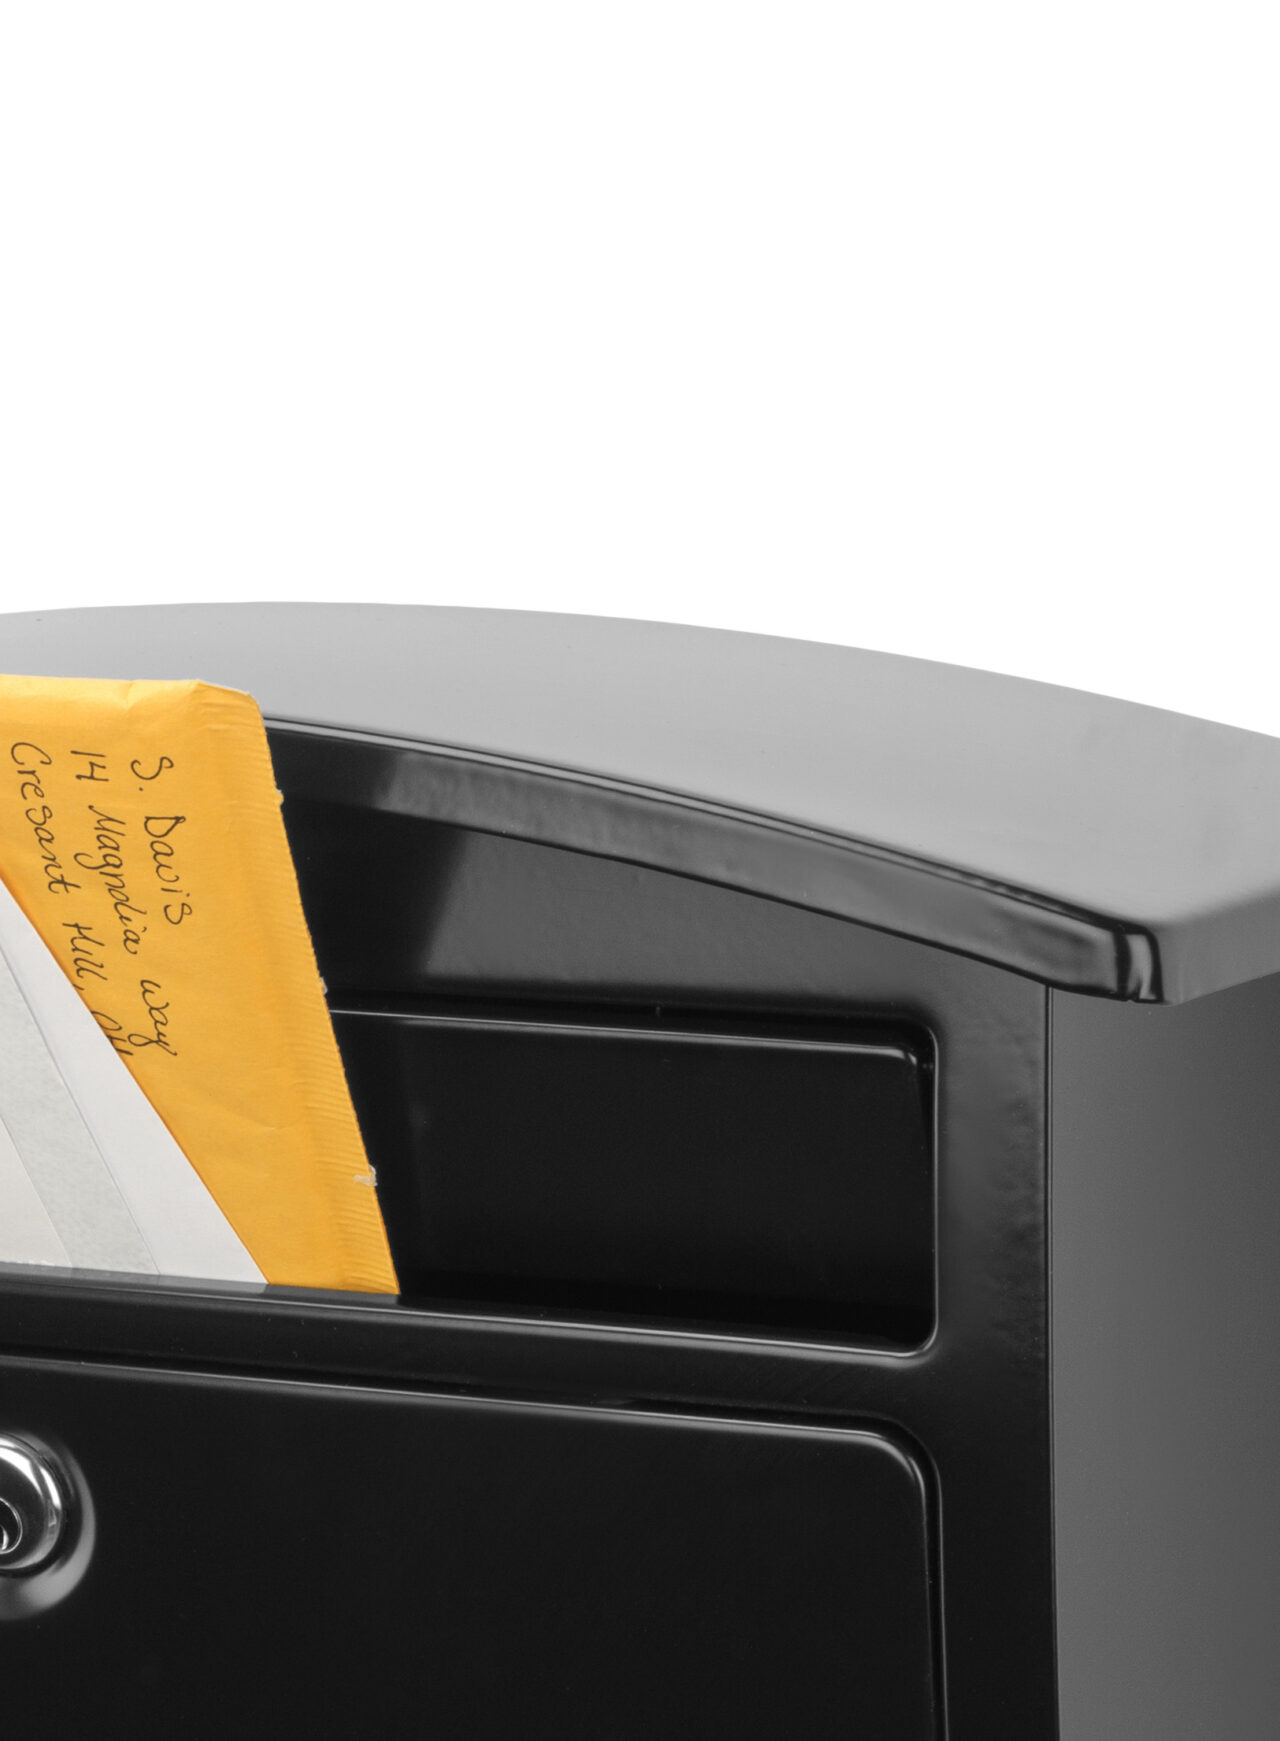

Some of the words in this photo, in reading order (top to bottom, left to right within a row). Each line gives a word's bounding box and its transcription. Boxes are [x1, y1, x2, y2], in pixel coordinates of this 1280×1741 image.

[10, 741, 81, 894] Cresant
[70, 749, 110, 782] 14
[130, 756, 174, 792] S.
[73, 804, 148, 955] Magnolia
[143, 815, 193, 925] Davis
